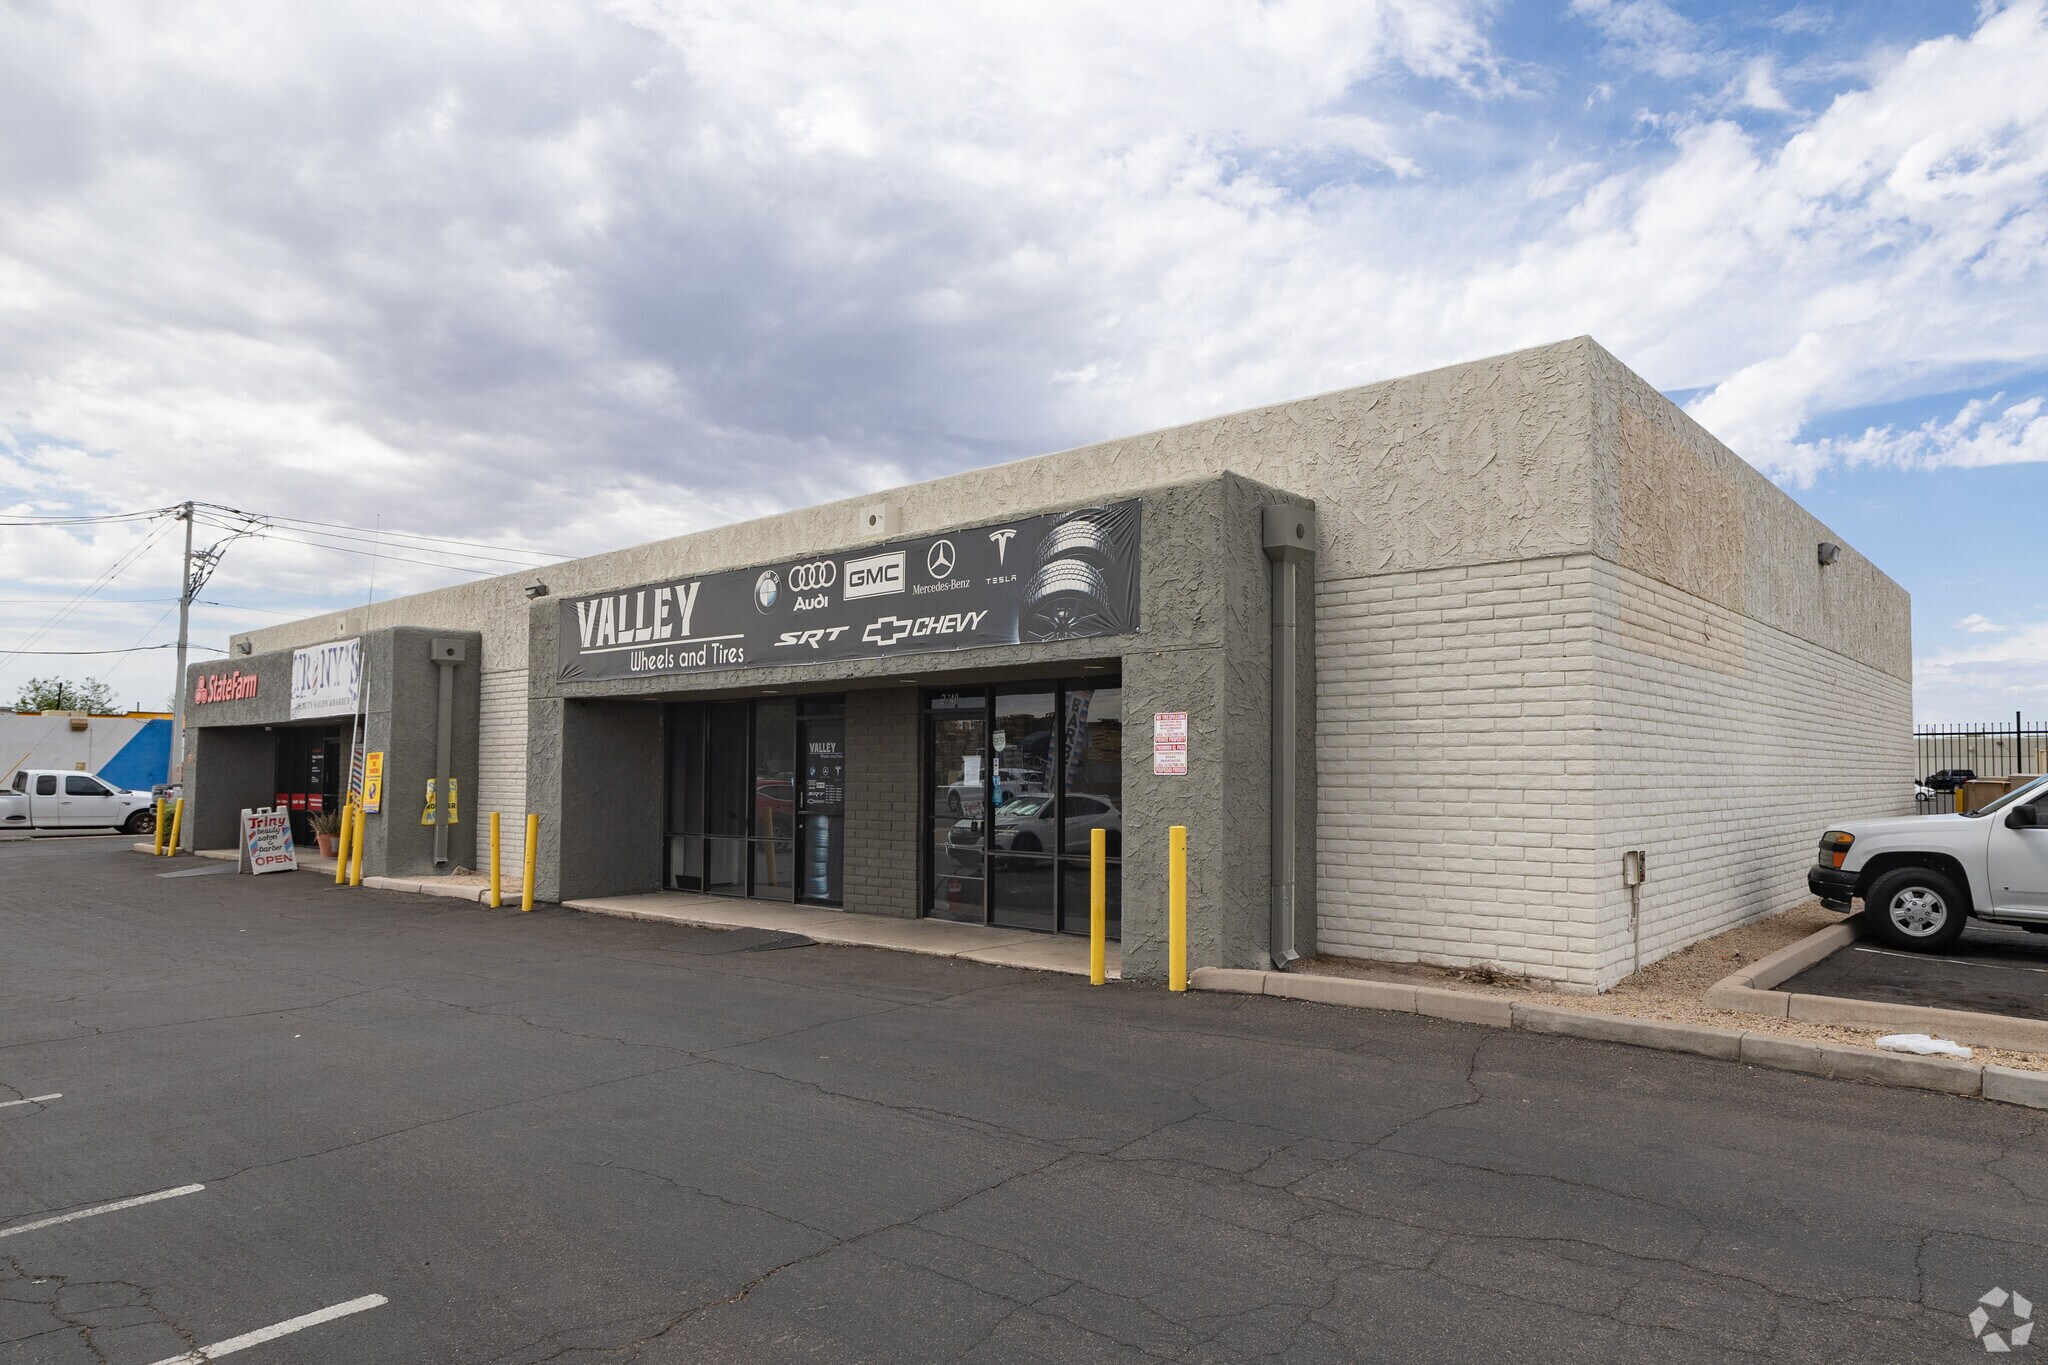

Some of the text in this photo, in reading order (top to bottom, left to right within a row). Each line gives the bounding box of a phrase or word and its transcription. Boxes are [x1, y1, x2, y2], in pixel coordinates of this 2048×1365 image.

[849, 563, 900, 588] GMC
[986, 575, 1017, 585] TESLA
[912, 578, 971, 596] Mercedes-Benz
[792, 593, 829, 612] Audi
[576, 582, 702, 648] VALLEY
[912, 610, 988, 637] CHEVY
[774, 625, 850, 649] SRT
[630, 642, 744, 671] Wheels and Tires
[809, 742, 836, 753] VALLEY
[248, 816, 286, 829] Triny
[257, 827, 280, 835] beauty
[258, 834, 278, 842] salon
[259, 845, 283, 853] barber
[255, 854, 293, 866] OPEN
